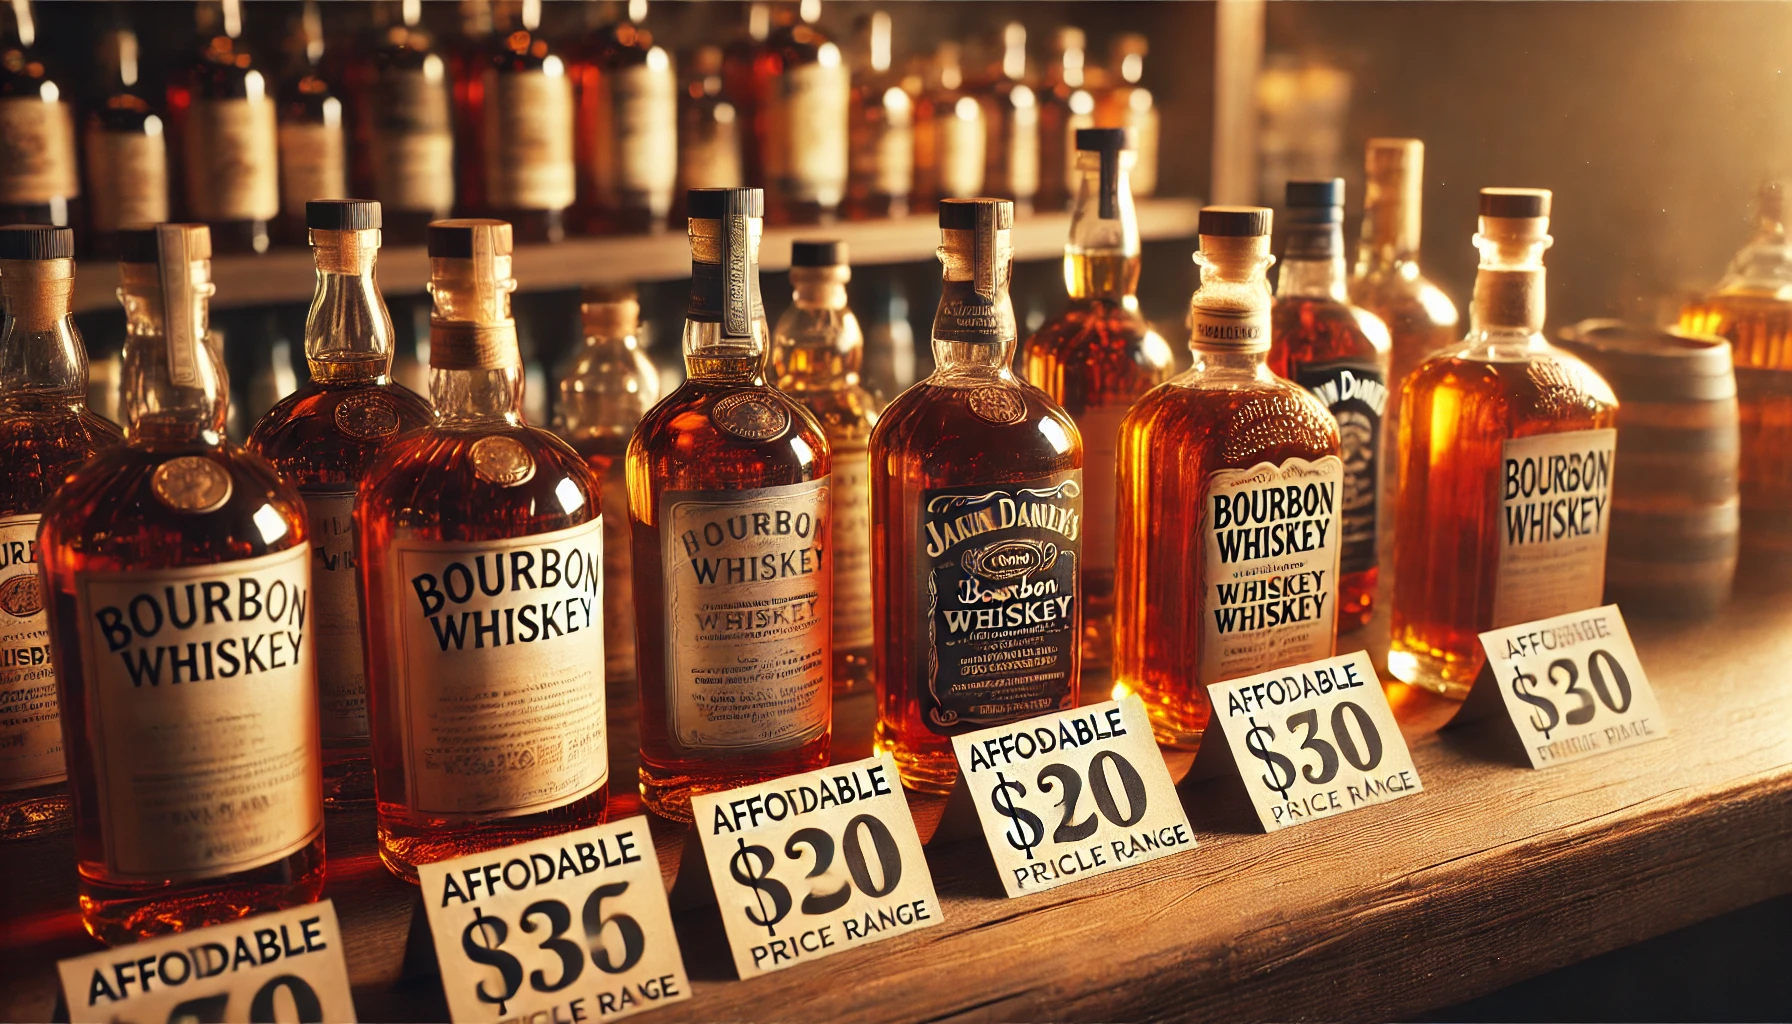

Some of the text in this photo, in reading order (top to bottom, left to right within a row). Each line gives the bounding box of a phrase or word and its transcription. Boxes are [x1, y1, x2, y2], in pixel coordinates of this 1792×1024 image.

[1504, 449, 1612, 501] BOURBON
[1213, 481, 1334, 529] BOURBON
[1505, 495, 1606, 546] WHISKEY
[690, 547, 824, 585] WHISKEY
[1216, 518, 1330, 564] WHISKEY
[411, 547, 599, 618] BOURBON
[1216, 570, 1325, 606] WHISKEY
[95, 577, 306, 653] BOURBON
[430, 597, 591, 651] WHISKEY
[942, 595, 1072, 633] WHISKEY
[1214, 592, 1327, 634] WHISKEY
[120, 631, 302, 688] WHISKEY
[1229, 662, 1364, 717] AFFODABLE
[1512, 649, 1632, 739] $30
[970, 708, 1127, 772] AFFODABLE
[1245, 701, 1382, 800] $30
[991, 750, 1147, 859] $20
[1271, 790, 1341, 824] PRICE
[441, 831, 642, 907] AFFODABLE
[1111, 823, 1189, 862] RANGE
[729, 813, 902, 936] $20
[751, 900, 930, 970] PRICE RANGE
